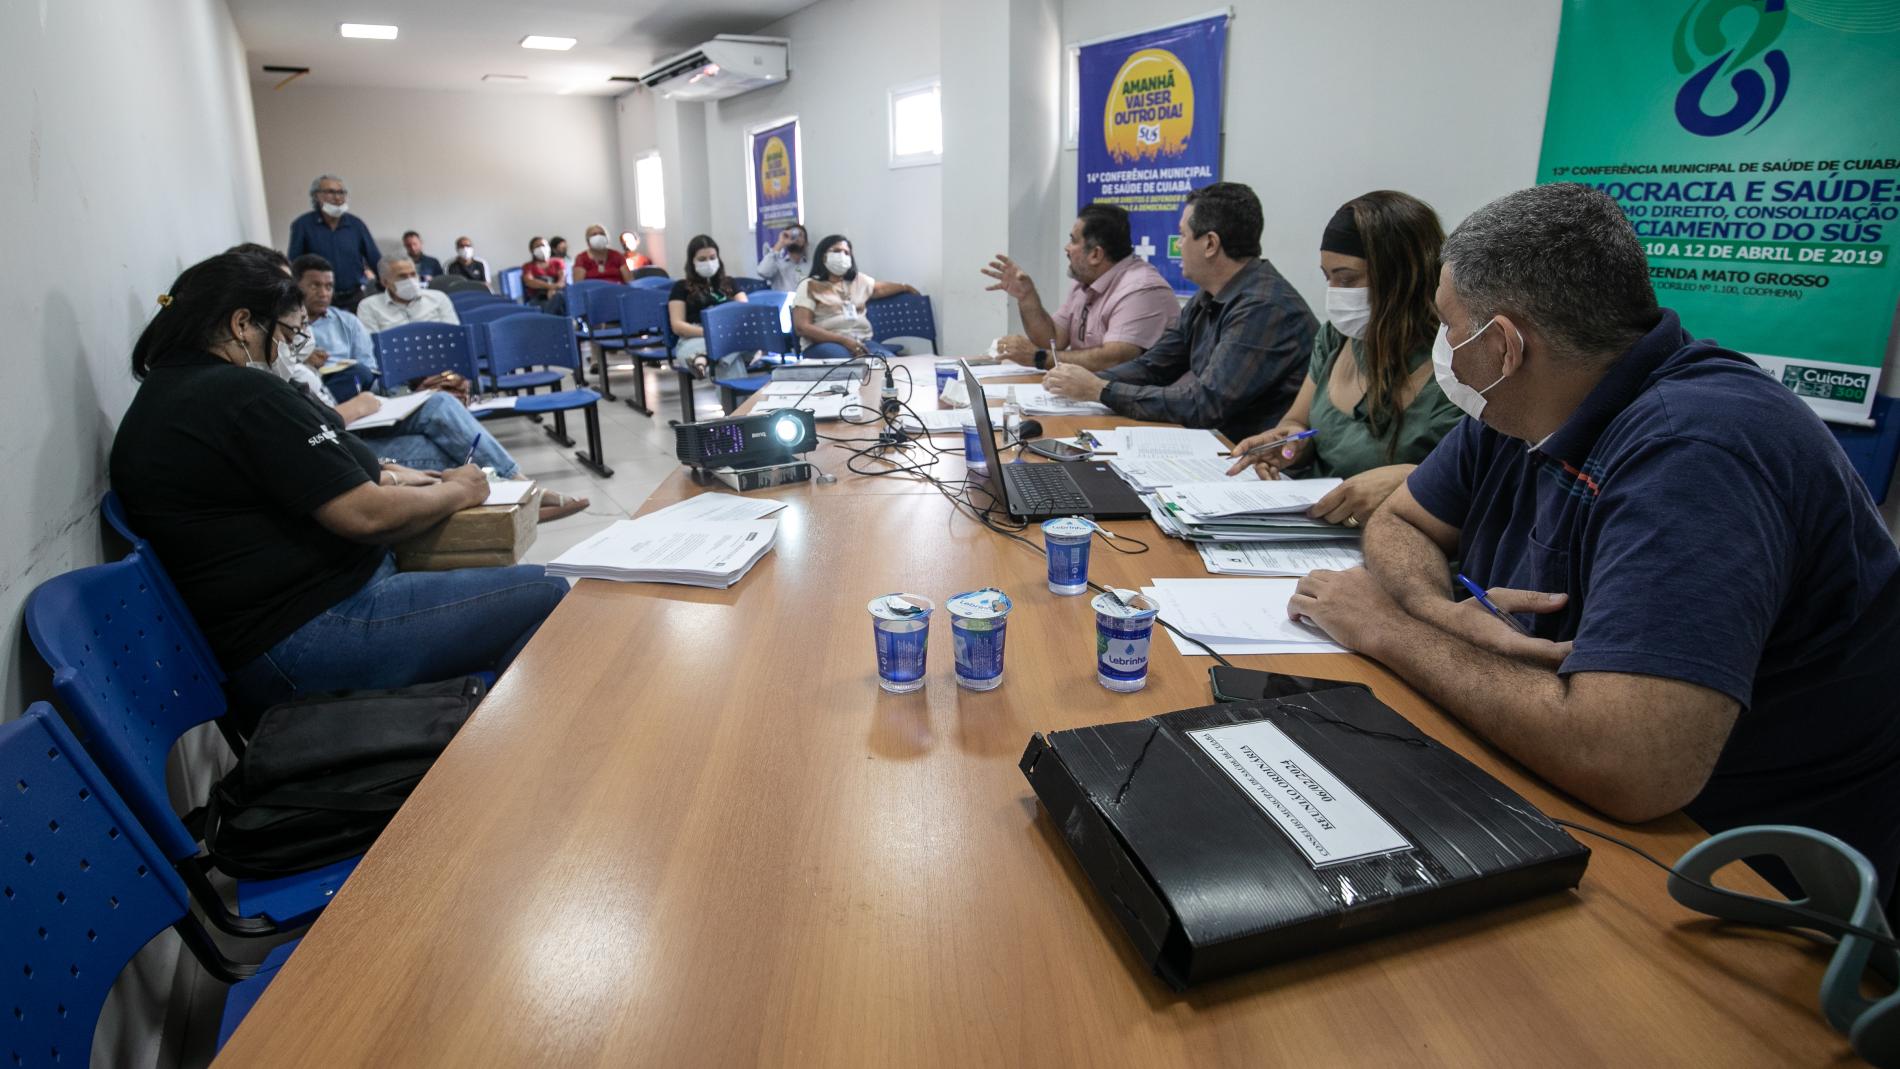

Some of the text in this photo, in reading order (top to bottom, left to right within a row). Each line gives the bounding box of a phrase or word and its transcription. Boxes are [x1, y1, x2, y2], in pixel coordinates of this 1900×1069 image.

[1122, 69, 1175, 95] AMANHÃ
[1126, 90, 1172, 109] VAI SER
[1114, 103, 1183, 126] OUTRO DIA!
[1138, 126, 1159, 142] SUS
[1100, 168, 1159, 182] CONFERÊNCIA
[1160, 165, 1212, 179] MUNICIPAL
[1571, 163, 1658, 176] CONFERÊNCIA
[1661, 163, 1735, 174] MUNICIPAL
[1739, 162, 1759, 173] DE
[1762, 159, 1814, 172] SAÚDE
[1817, 160, 1840, 171] DE
[1102, 177, 1192, 195] DE SAÚDE DE CUIABÁ
[1587, 172, 1900, 202] OCRACIA E SAÚDE:
[1623, 203, 1898, 223] MO DIREITO, CONSOLIDAÇÃO
[1630, 220, 1883, 243] CIAMENTO DO SUS
[1646, 243, 1883, 265] 10 A 12 DE ABRIL DE 2019
[1649, 267, 1830, 288] ZENDA MATO GROSSO
[1803, 369, 1867, 389] Cuiabá
[1836, 388, 1864, 399] 300
[308, 433, 325, 447] SUS
[1240, 745, 1333, 831] REUNIÃO ORDINÁRIA
[1280, 759, 1333, 802] 06/02/2024
[1290, 818, 1330, 856] CONSELHO
